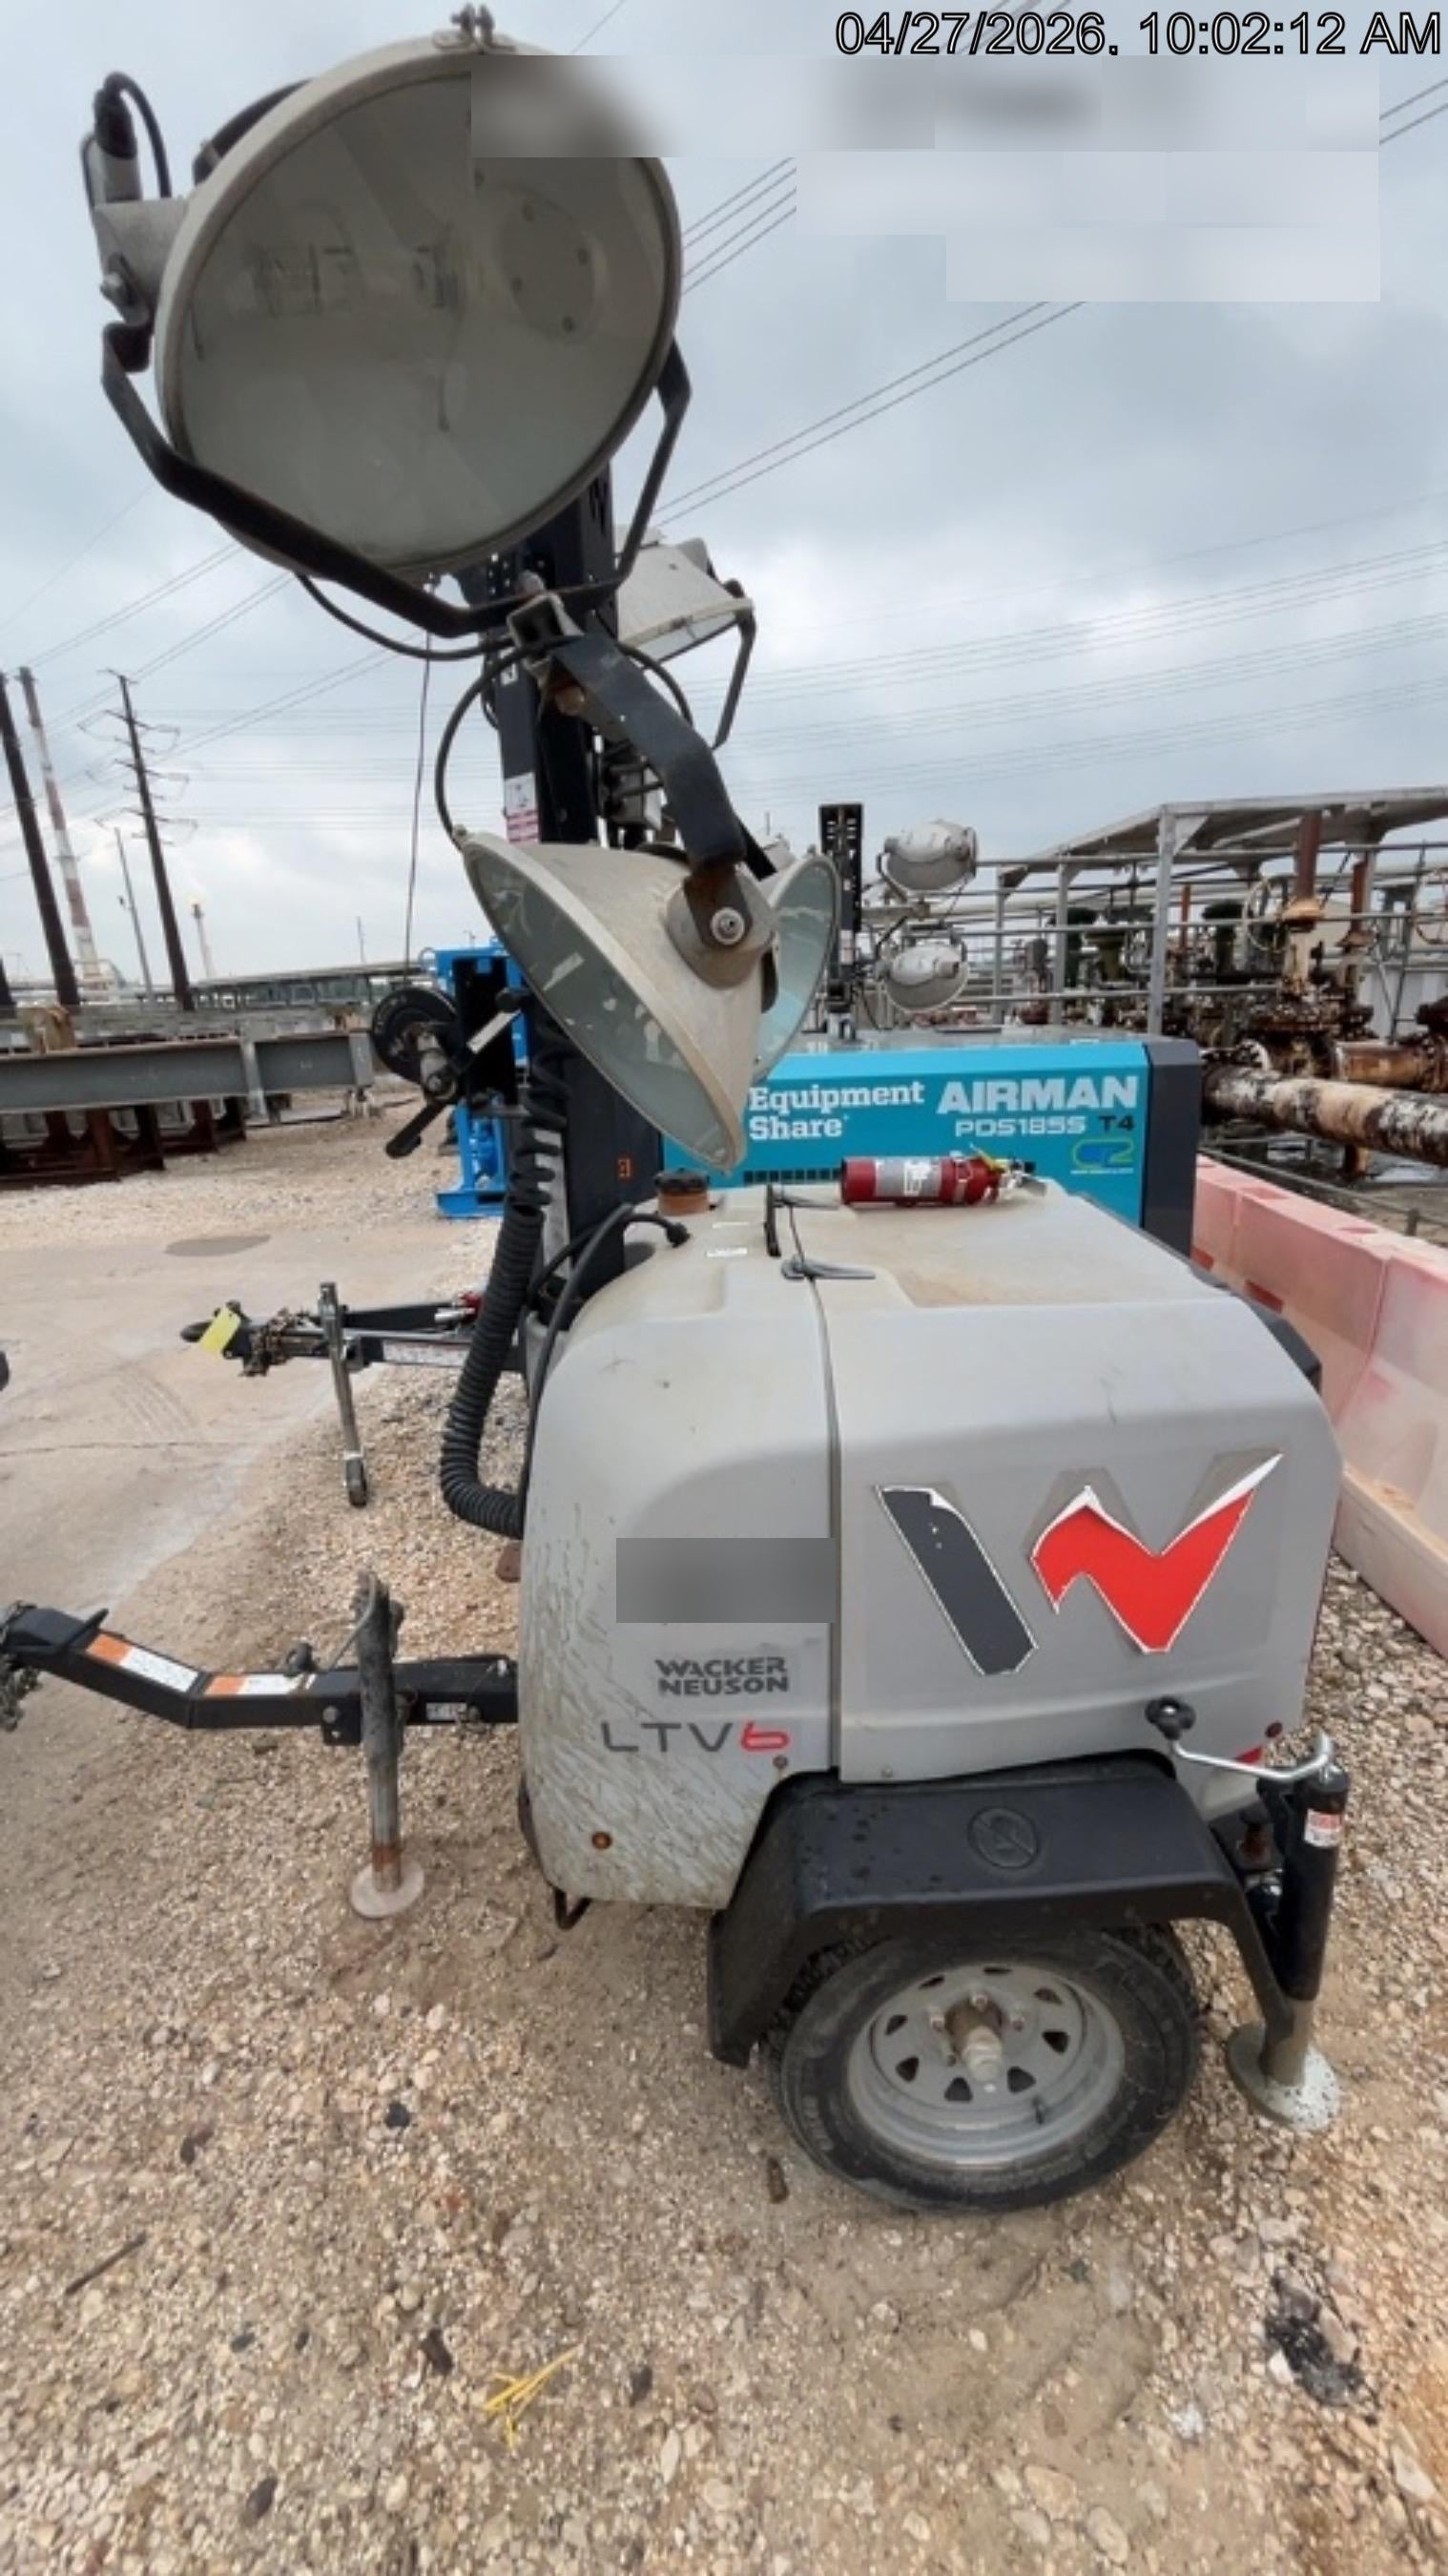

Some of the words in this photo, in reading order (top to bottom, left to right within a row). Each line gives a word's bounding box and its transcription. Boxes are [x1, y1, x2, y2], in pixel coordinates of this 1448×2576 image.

[748, 1081, 924, 1116] Equipment
[936, 1075, 1139, 1114] AIRMAN
[748, 1115, 843, 1141] Share
[955, 1115, 1086, 1137] PDS185S
[1100, 1114, 1134, 1132] T4
[655, 1656, 788, 1677] WACKER
[658, 1676, 788, 1695] NEUSON
[600, 1721, 791, 1754] LTV6
